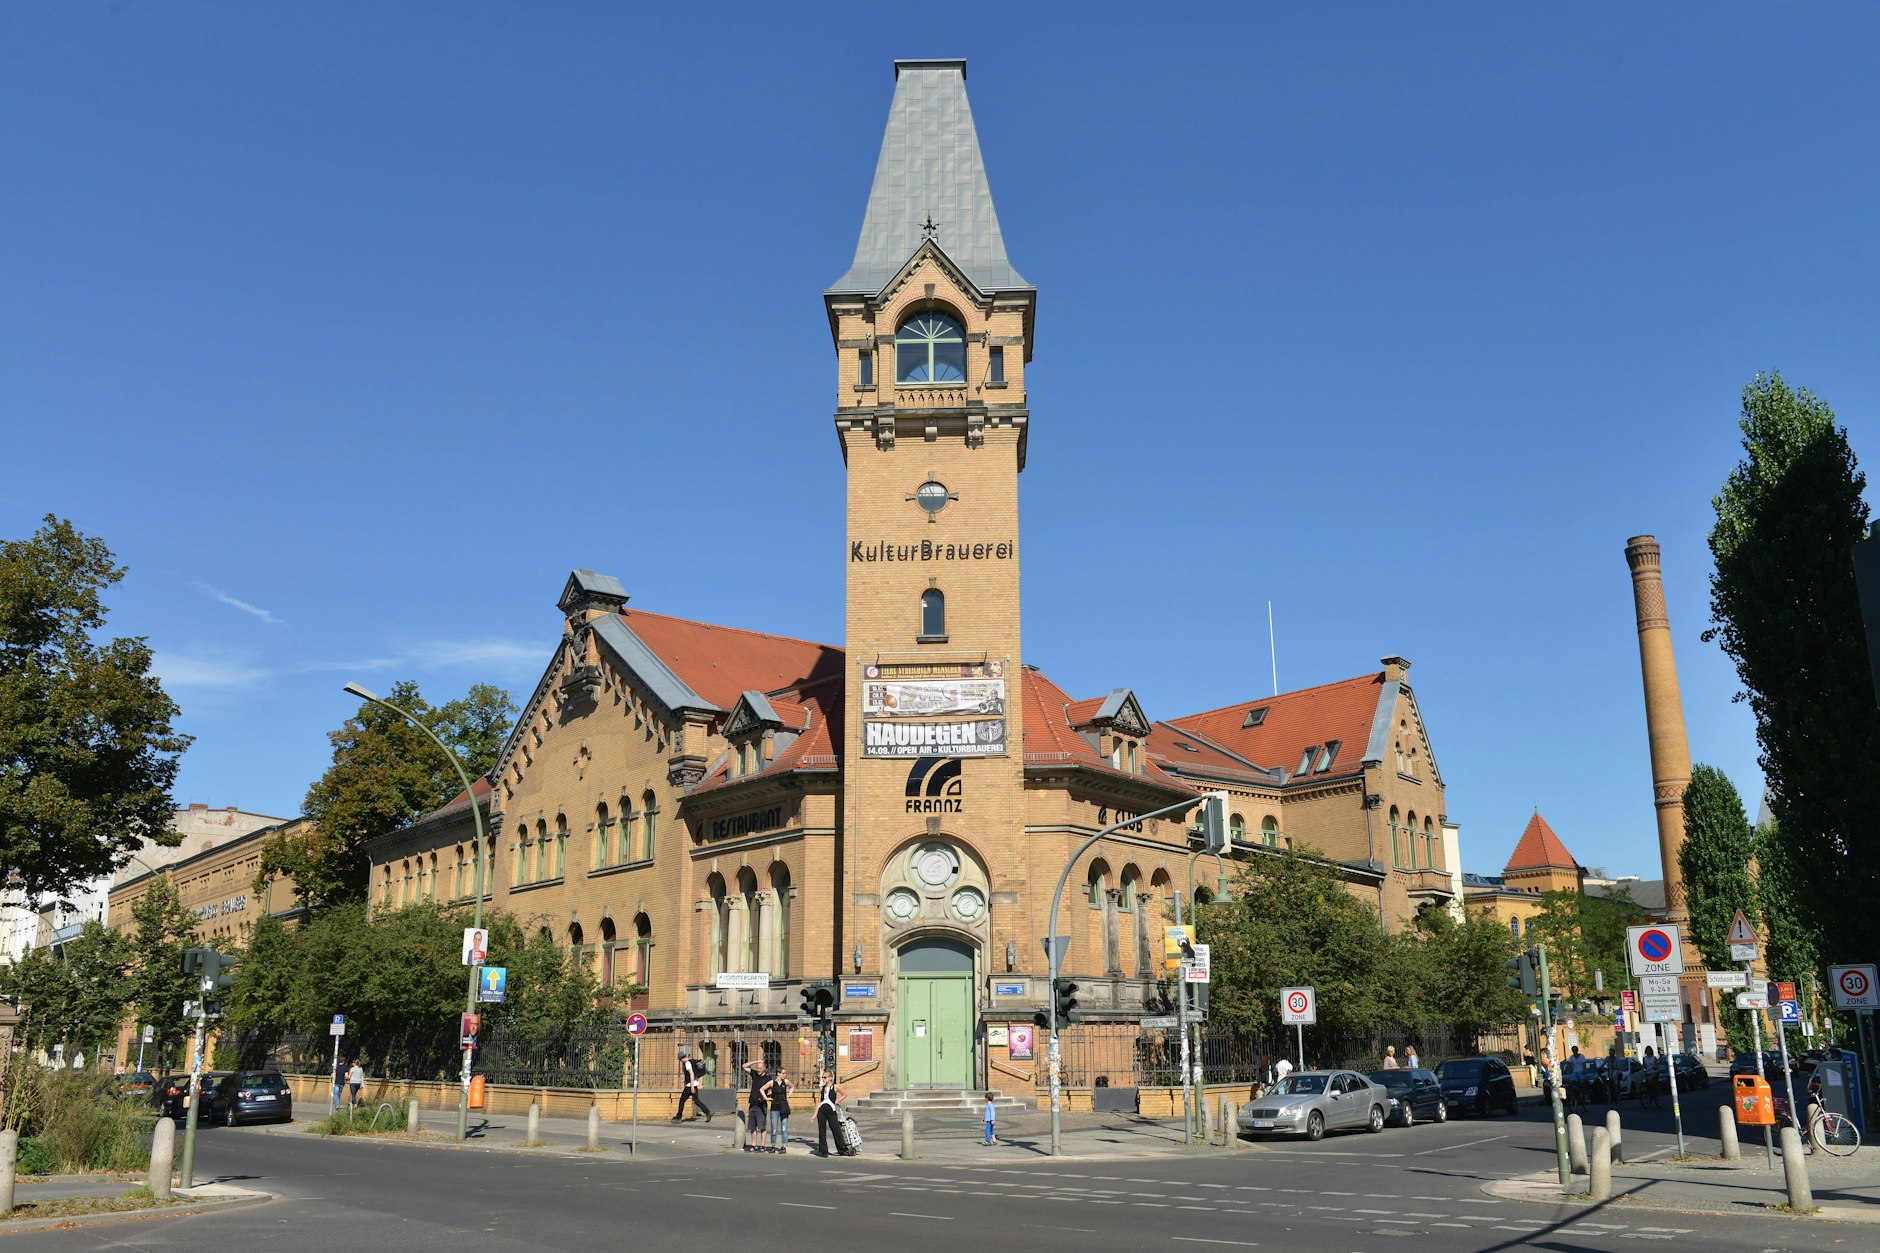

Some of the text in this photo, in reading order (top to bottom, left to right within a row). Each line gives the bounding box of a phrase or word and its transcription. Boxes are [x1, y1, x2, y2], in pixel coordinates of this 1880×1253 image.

[851, 539, 1013, 562] KulturBrauerei
[866, 722, 976, 746] HAUDEGEN
[867, 747, 890, 755] 14.09.
[897, 746, 917, 754] OPEN
[919, 746, 932, 754] AIR
[938, 743, 1004, 753] KULTURBRAUEREI
[905, 799, 962, 813] FRANNZ
[713, 807, 782, 839] RESTAURANT
[1645, 963, 1671, 972] ZONE
[1845, 977, 1863, 990] 30
[1292, 997, 1304, 1008] 30
[1846, 997, 1869, 1005] ZONE
